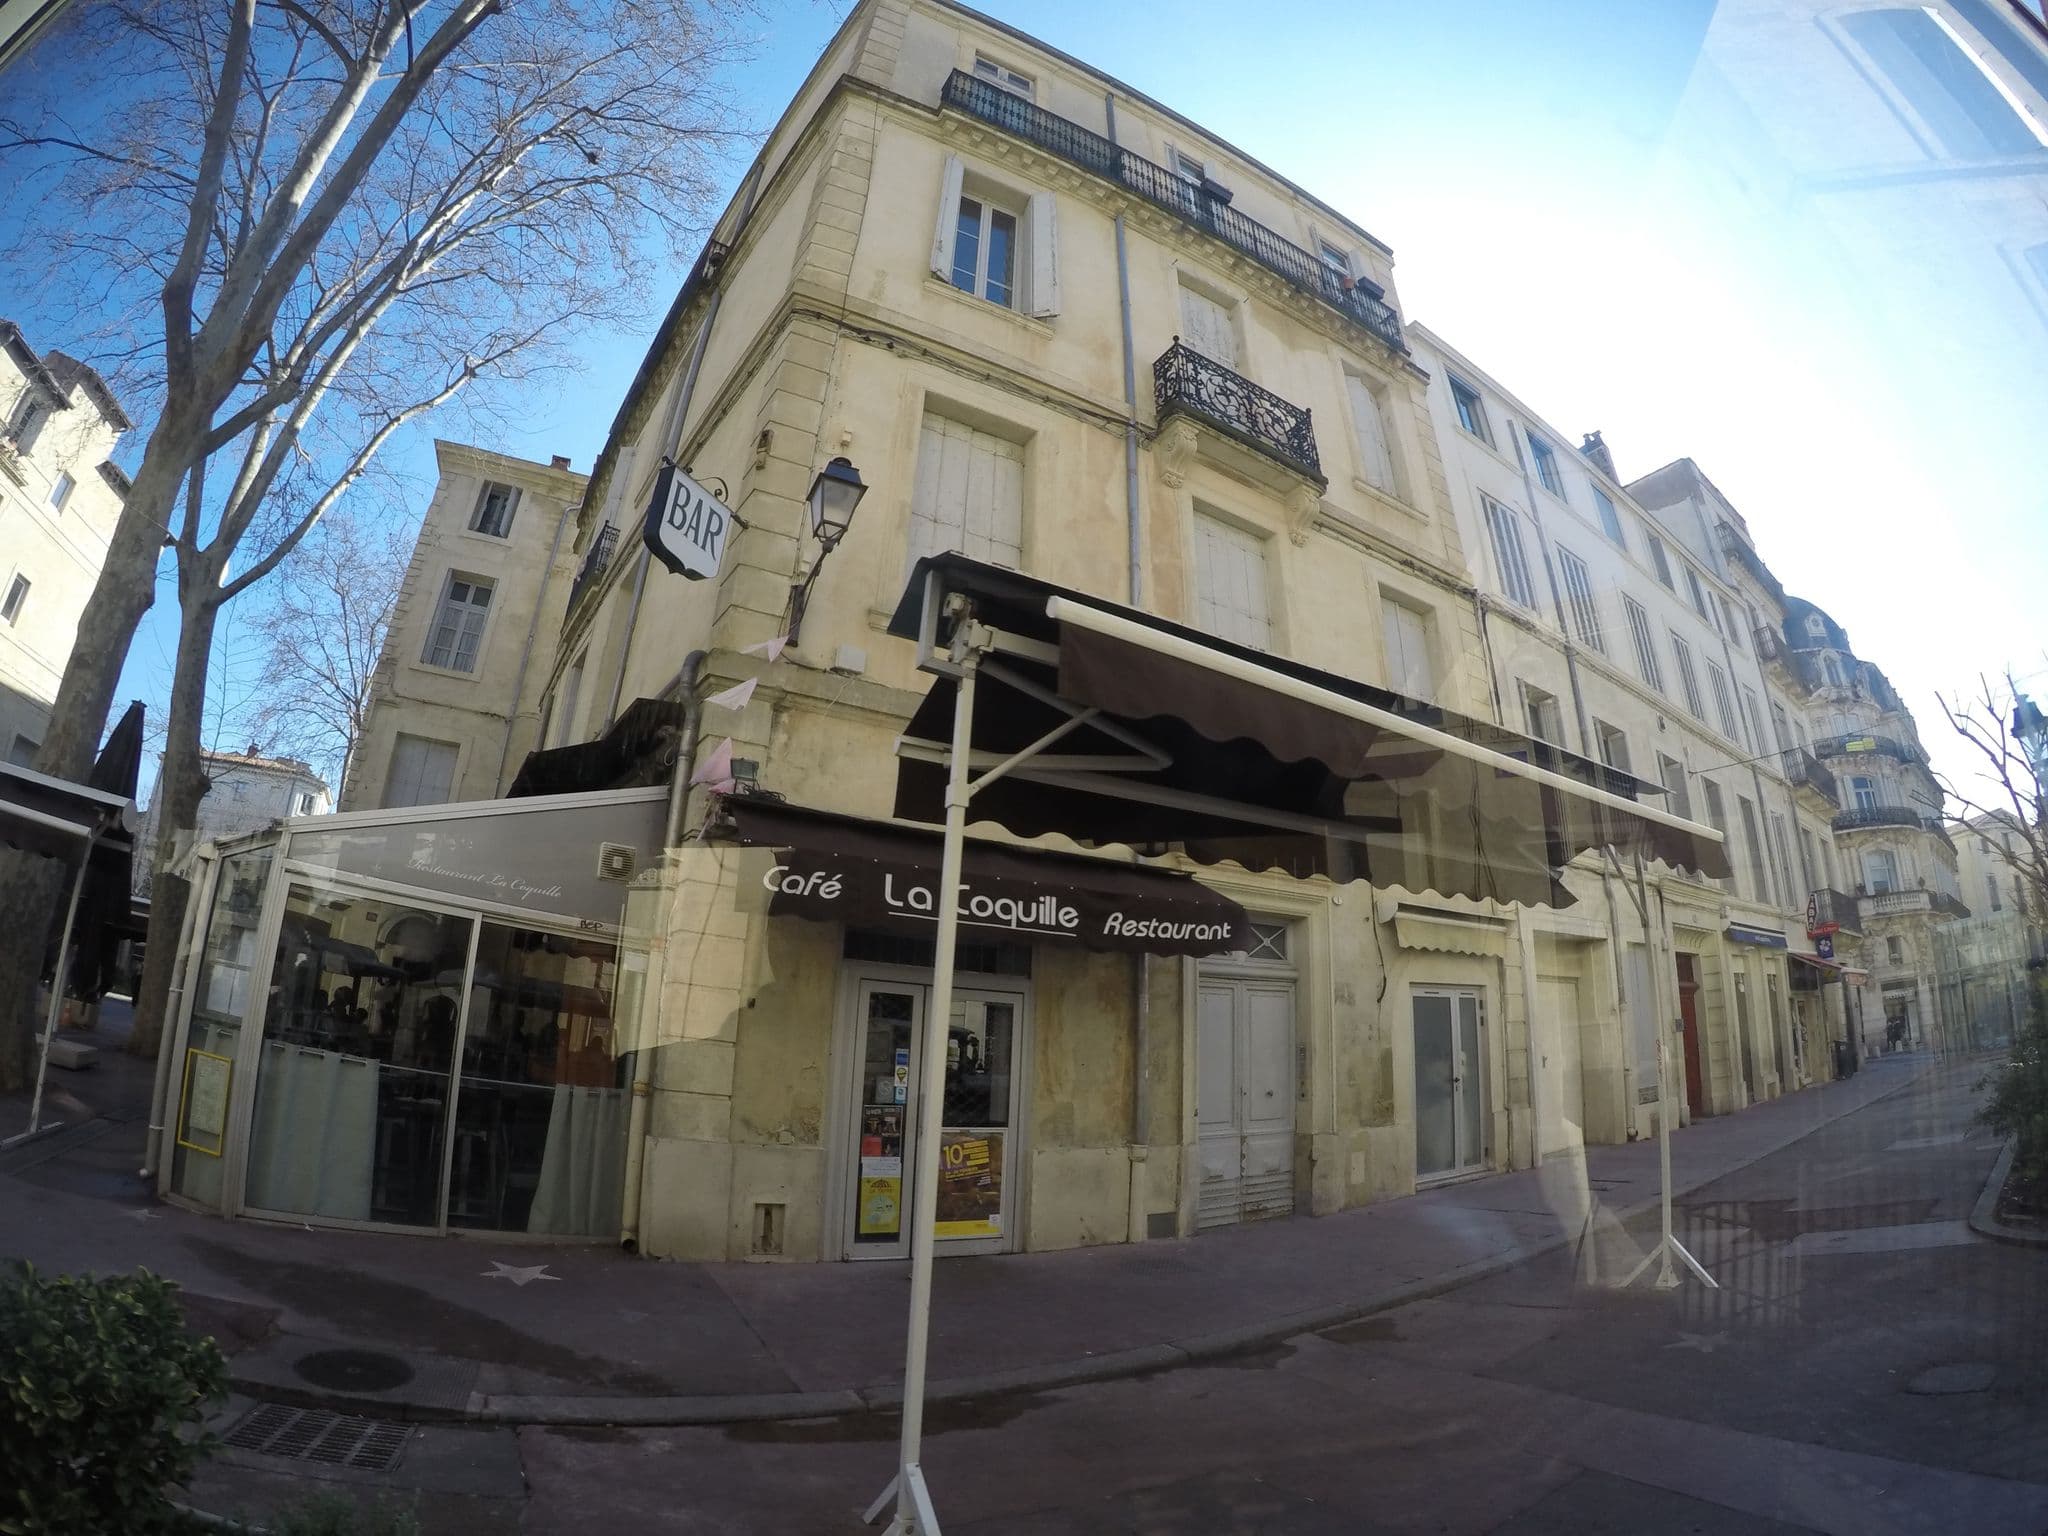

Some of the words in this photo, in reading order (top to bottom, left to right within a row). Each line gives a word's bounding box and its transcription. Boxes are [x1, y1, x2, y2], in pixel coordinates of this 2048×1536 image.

[666, 481, 723, 561] BAR
[407, 857, 484, 883] Restaurant
[486, 872, 508, 887] La
[510, 878, 562, 900] Coquille
[763, 865, 843, 899] Café
[884, 873, 933, 910] La
[1103, 911, 1231, 940] Restaurant
[1808, 895, 1817, 931] TABAC
[943, 1144, 963, 1169] 10
